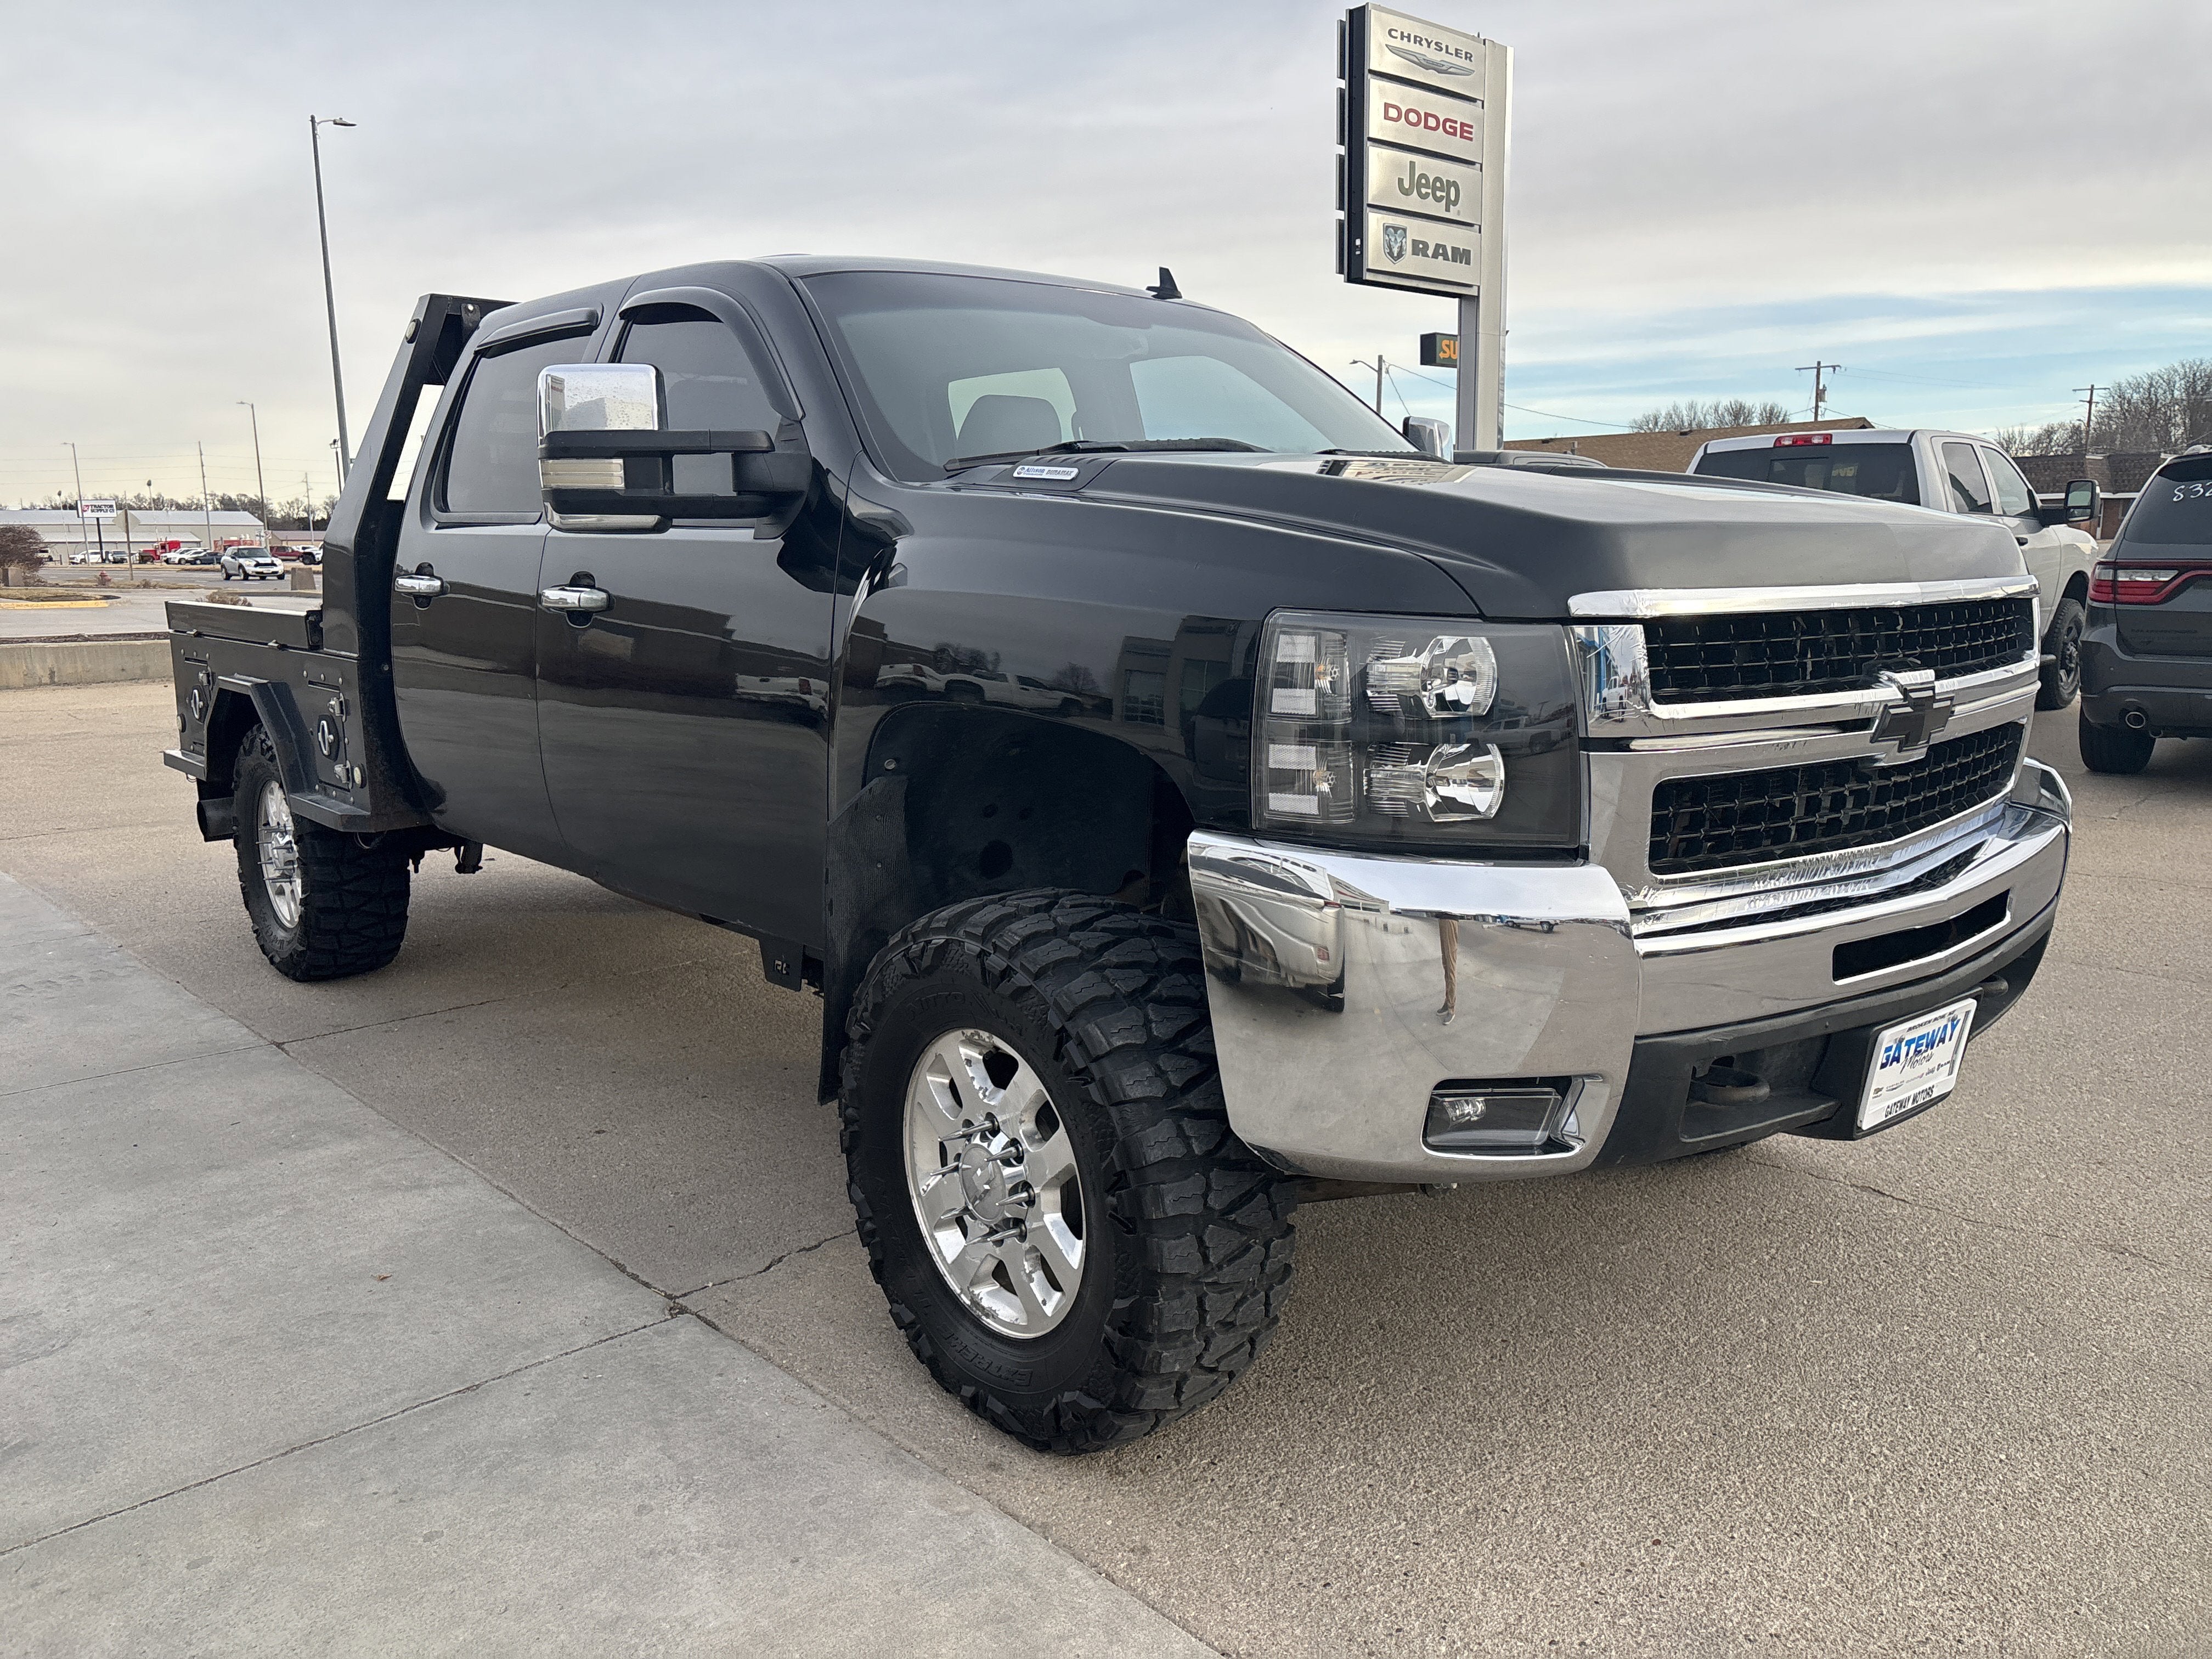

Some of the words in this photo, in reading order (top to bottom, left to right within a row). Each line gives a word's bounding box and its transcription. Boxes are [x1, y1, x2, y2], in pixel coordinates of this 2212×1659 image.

[1387, 28, 1473, 63] CHRYSLER
[1384, 102, 1474, 142] DODGE
[1398, 161, 1460, 212] Jeep
[1412, 239, 1471, 266] RAM
[1880, 1018, 1961, 1070] GATEWAY
[1900, 1051, 1934, 1074] Motors
[1884, 1094, 1912, 1118] GATEWAY
[1911, 1085, 1935, 1106] MOTORS
[936, 1323, 1034, 1387] EXTREME
